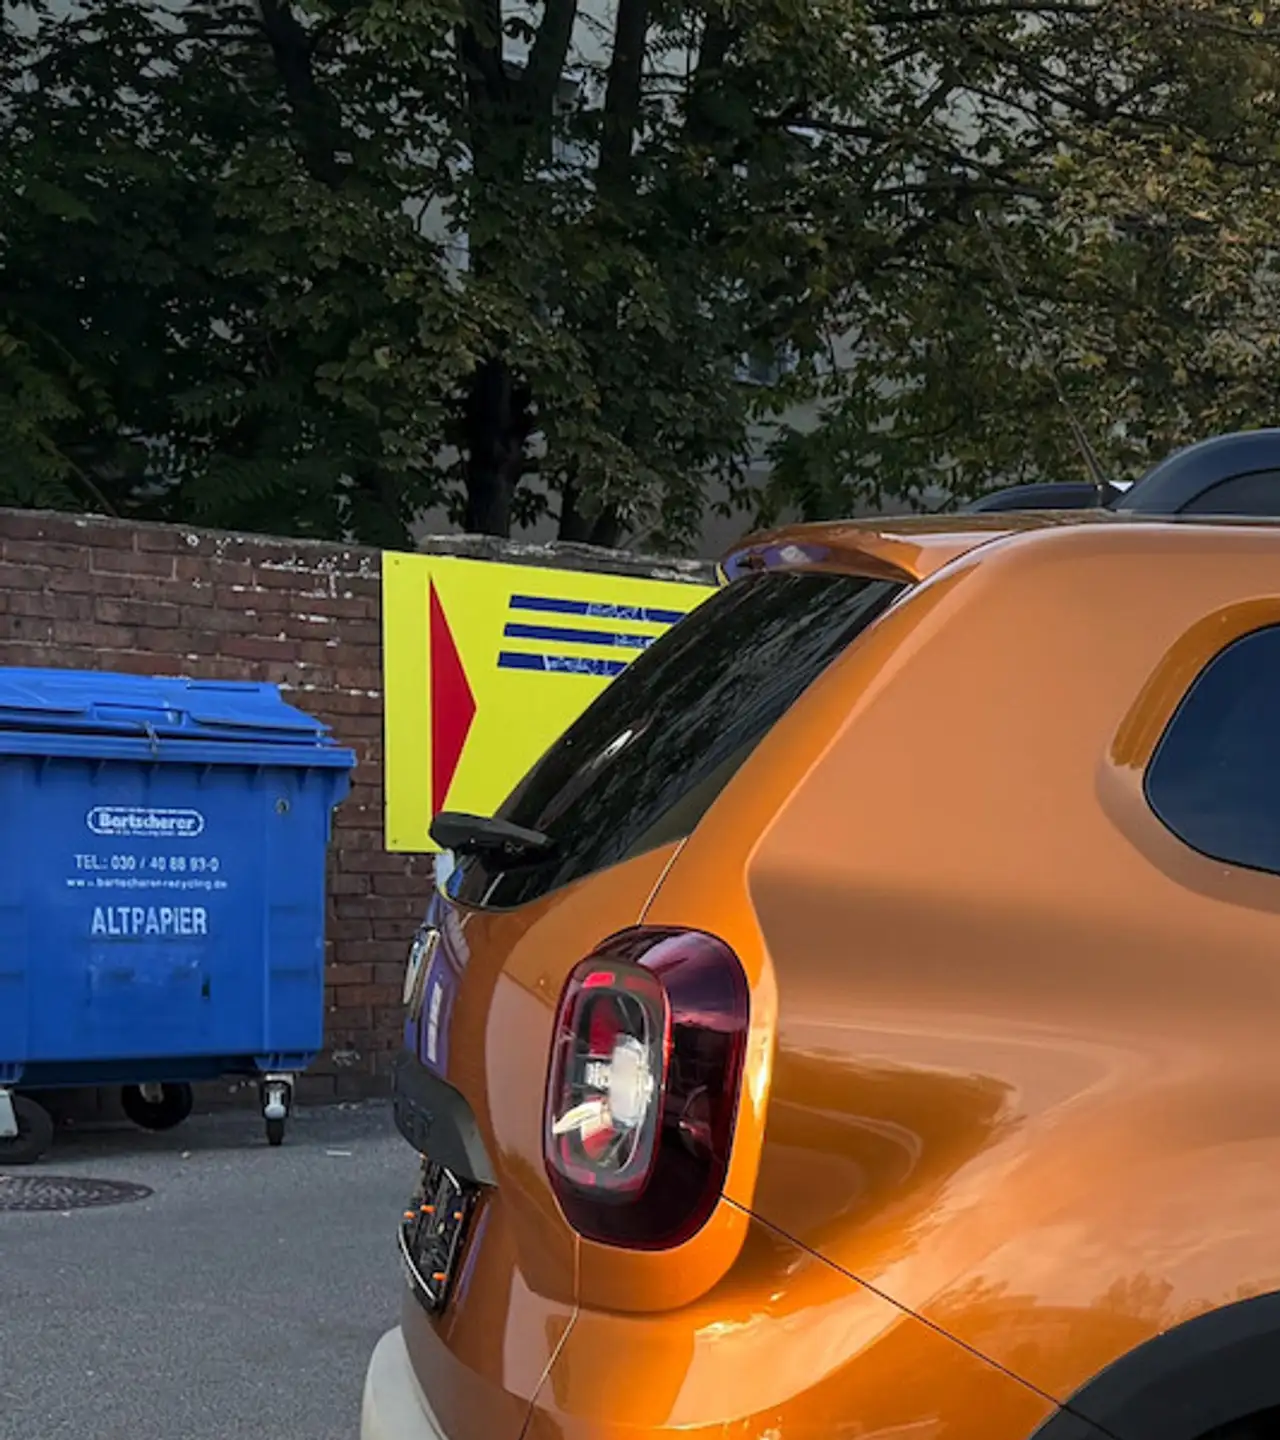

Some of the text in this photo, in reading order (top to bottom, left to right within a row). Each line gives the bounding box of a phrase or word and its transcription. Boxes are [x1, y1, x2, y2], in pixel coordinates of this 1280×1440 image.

[98, 812, 195, 830] Bartscherer
[111, 855, 136, 871] 030
[139, 857, 146, 870] /
[150, 856, 165, 872] 40
[91, 906, 208, 935] ALTPAPIER
